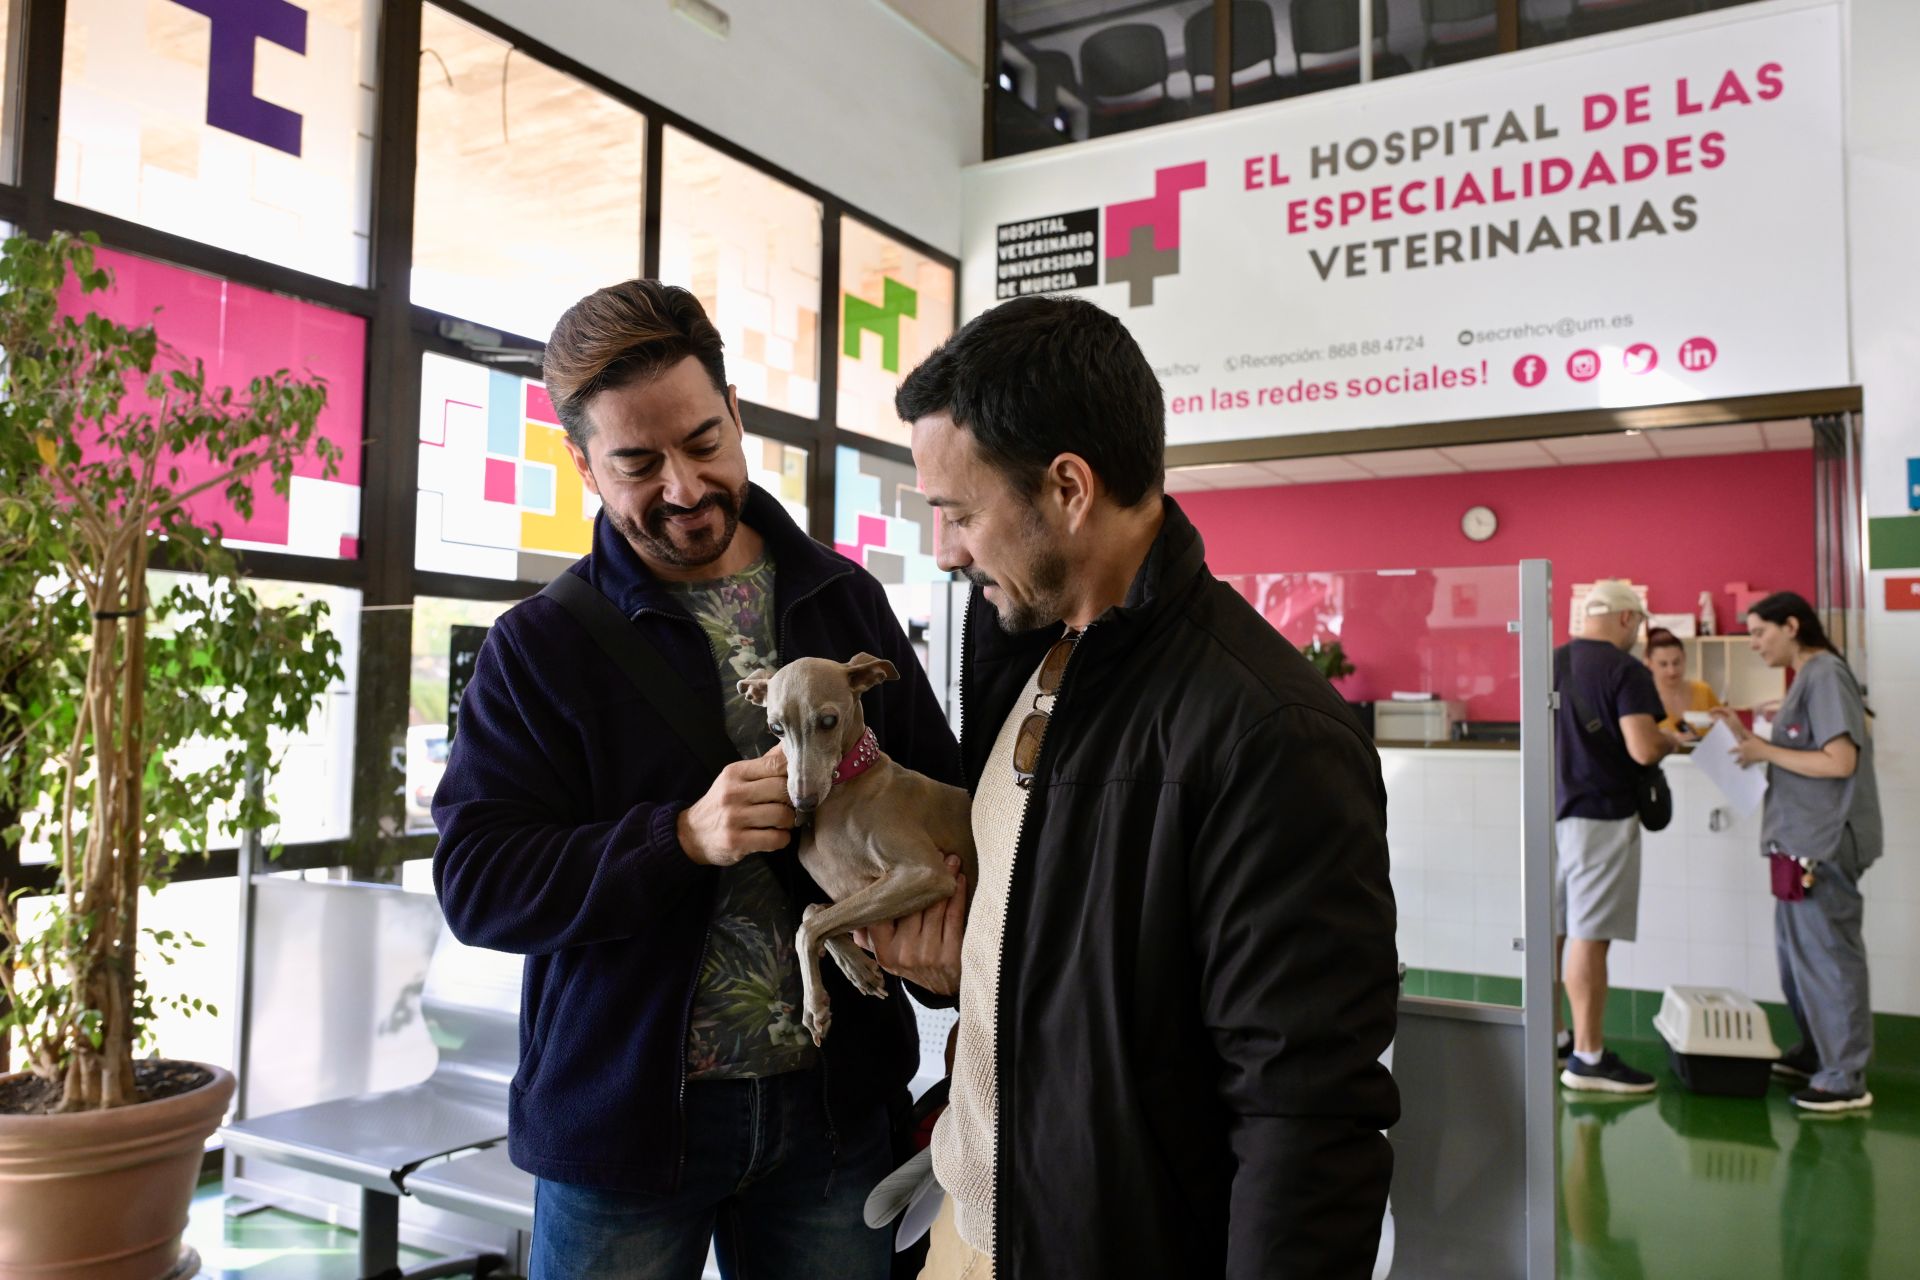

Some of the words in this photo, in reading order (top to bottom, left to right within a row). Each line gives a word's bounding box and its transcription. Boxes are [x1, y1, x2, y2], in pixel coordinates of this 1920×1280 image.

[1244, 154, 1290, 190] EL
[1310, 104, 1559, 180] HOSPITAL
[1583, 84, 1651, 133] DE
[1676, 62, 1784, 116] LAS
[1288, 130, 1727, 235] ESPECIALIDADES
[998, 217, 1068, 242] HOSPITAL
[998, 231, 1094, 260] VETERINARIO
[1308, 194, 1698, 282] VETERINARIAS
[998, 250, 1094, 279] UNIVERSIDAD
[999, 281, 1018, 299] DE
[1020, 272, 1077, 294] MURCIA
[1475, 313, 1634, 344] secrehcv@um.es
[1240, 349, 1324, 370] Recepción:
[1328, 341, 1358, 360] 868
[1361, 339, 1381, 356] 88
[1384, 335, 1425, 353] 4724
[1171, 395, 1204, 414] en
[1211, 388, 1251, 411] las
[1257, 379, 1338, 406] redes
[1346, 360, 1488, 398] sociales!
